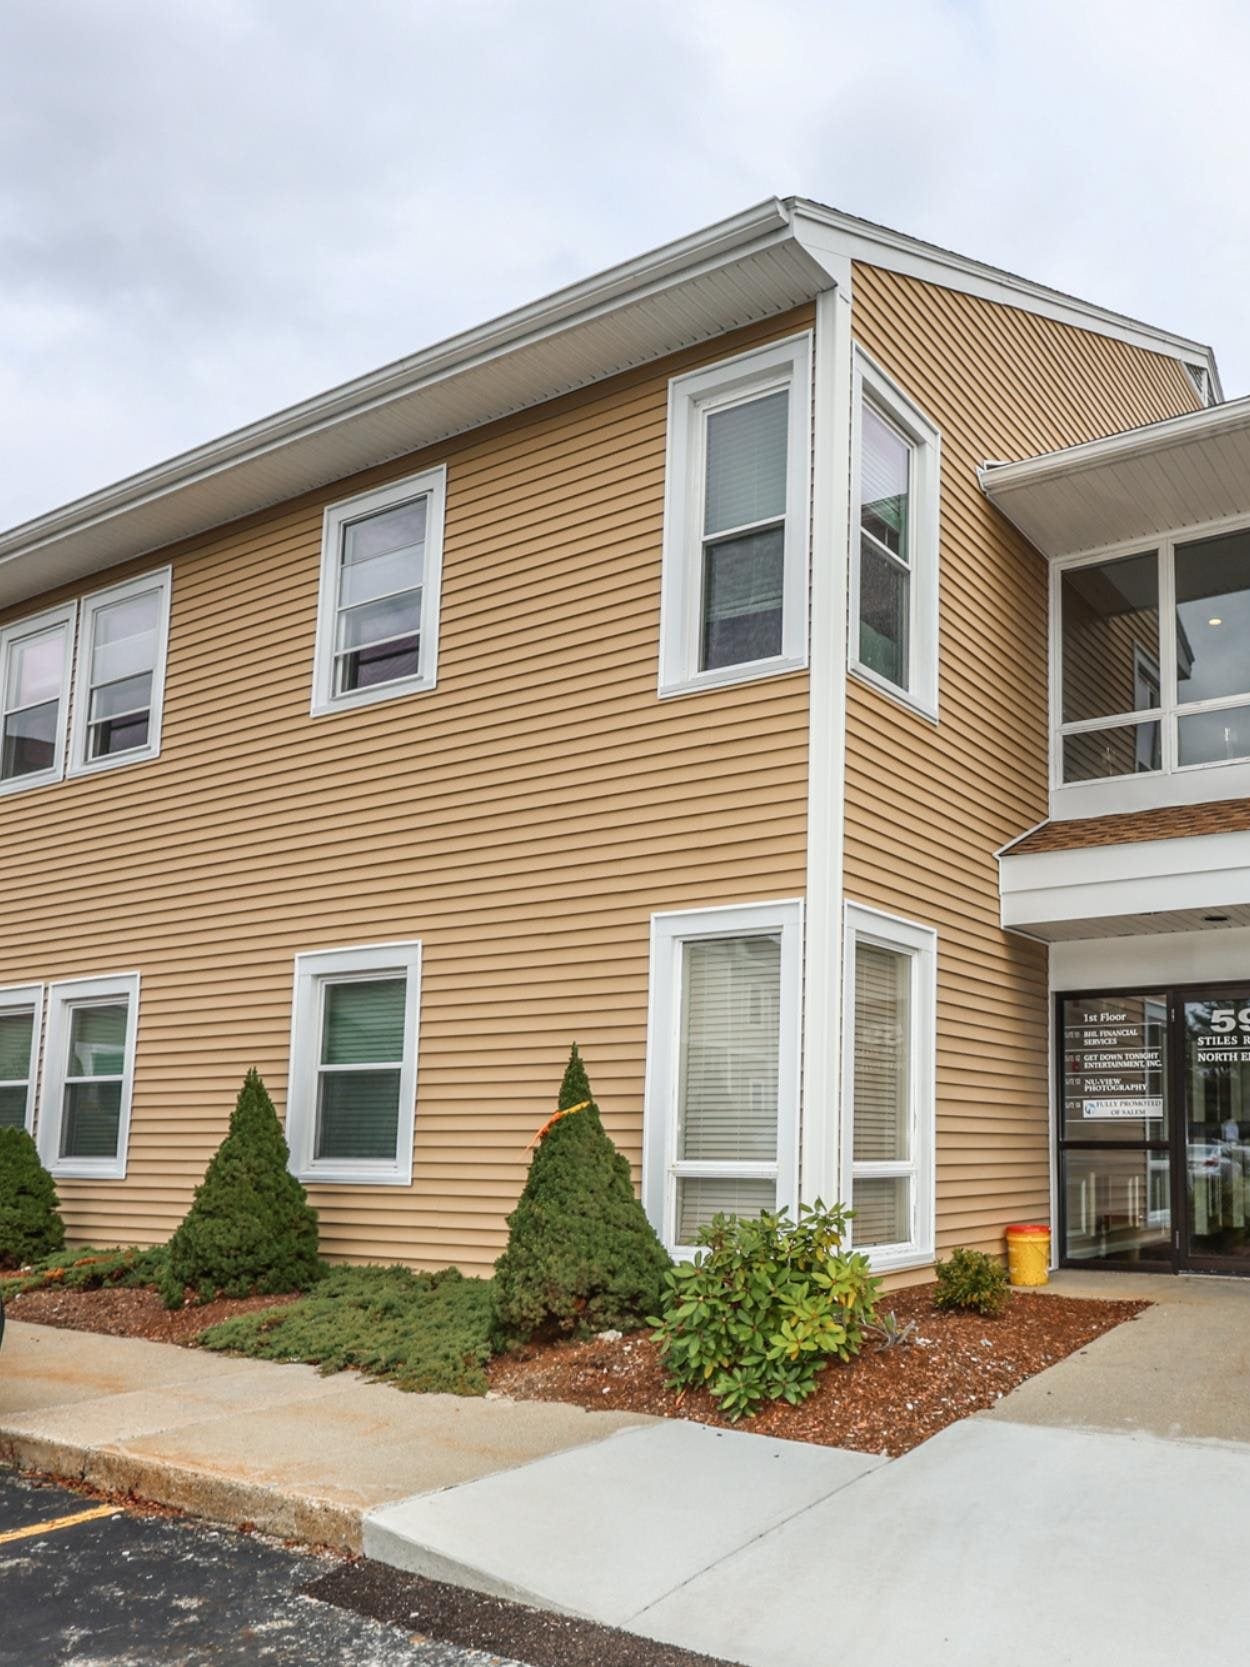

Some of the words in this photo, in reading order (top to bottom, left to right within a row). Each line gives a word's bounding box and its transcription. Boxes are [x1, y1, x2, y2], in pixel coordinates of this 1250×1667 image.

[1083, 1013, 1098, 1023] 1st
[1100, 1012, 1127, 1022] Floor
[1100, 1029, 1138, 1037] FINANCIAL
[1083, 1038, 1118, 1046] SERVICES
[1197, 1035, 1238, 1046] STILES
[1100, 1053, 1123, 1061] DOWN
[1124, 1052, 1159, 1060] TONIGHT
[1197, 1052, 1238, 1062] NORTH
[1147, 1060, 1162, 1068] INC.
[1084, 1083, 1147, 1092] PHOTOGRAPHY
[1120, 1099, 1162, 1107] PROMOTED
